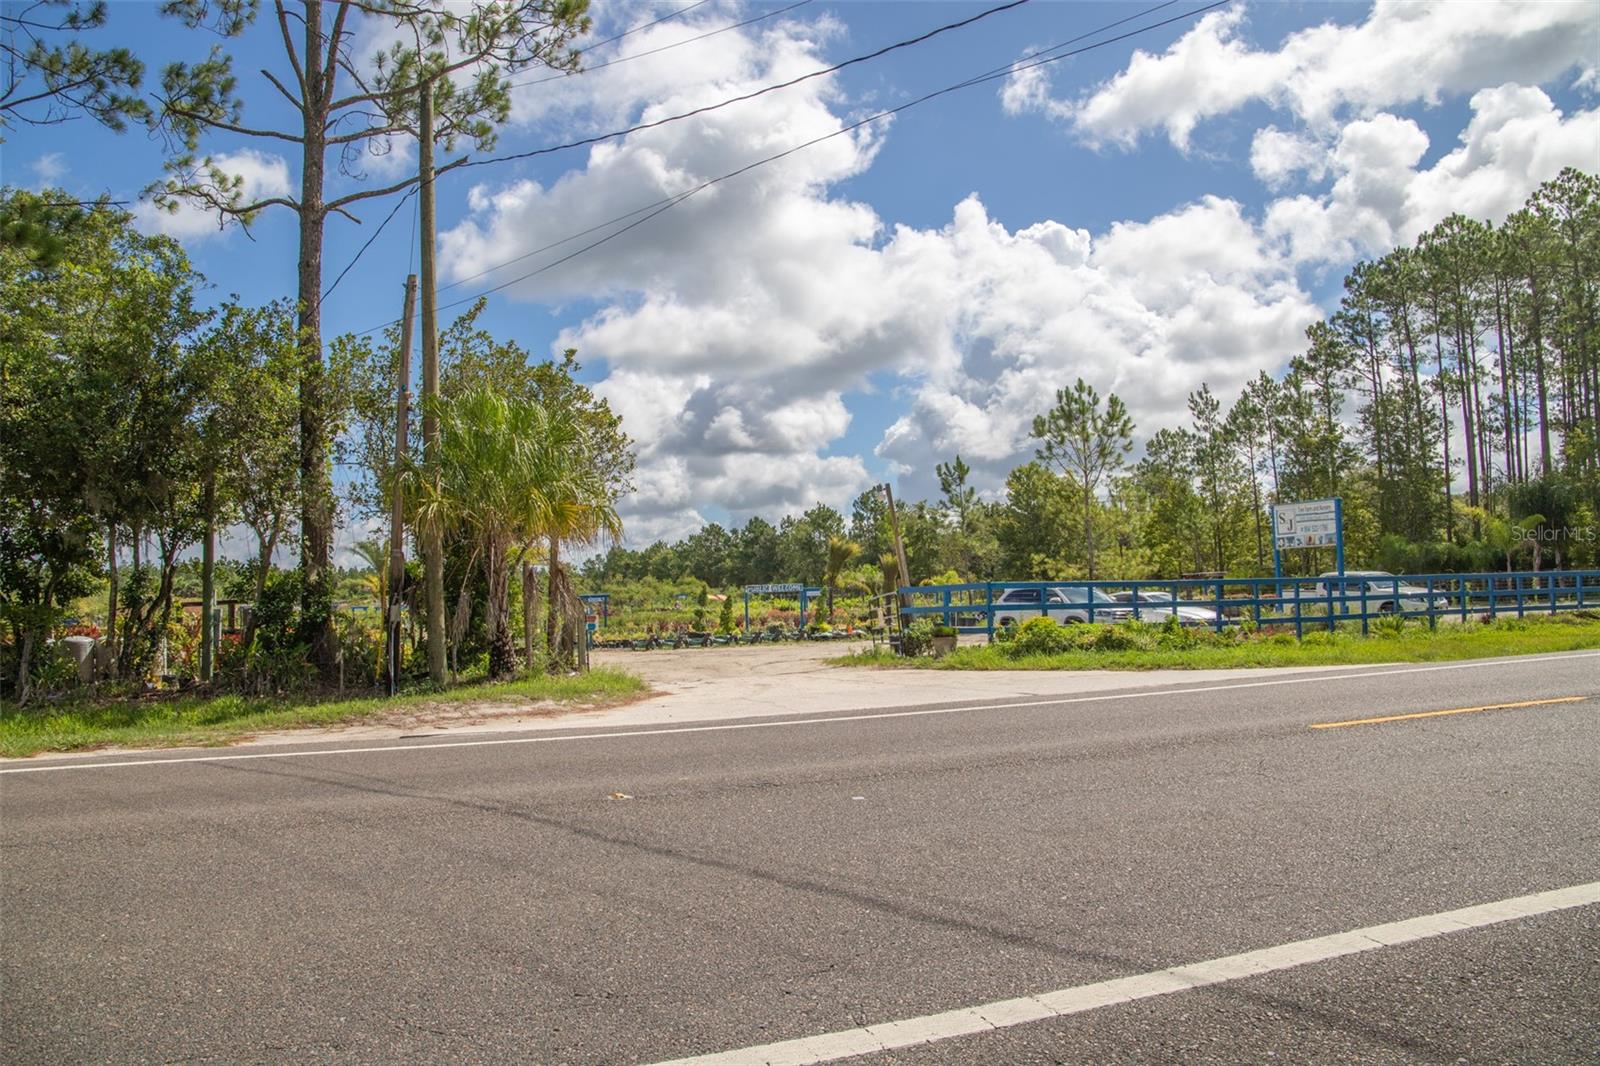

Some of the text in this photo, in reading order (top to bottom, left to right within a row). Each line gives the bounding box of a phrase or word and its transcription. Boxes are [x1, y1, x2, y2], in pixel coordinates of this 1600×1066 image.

[1279, 512, 1285, 524] S
[1287, 519, 1293, 531] J
[770, 583, 802, 592] WELCOME
